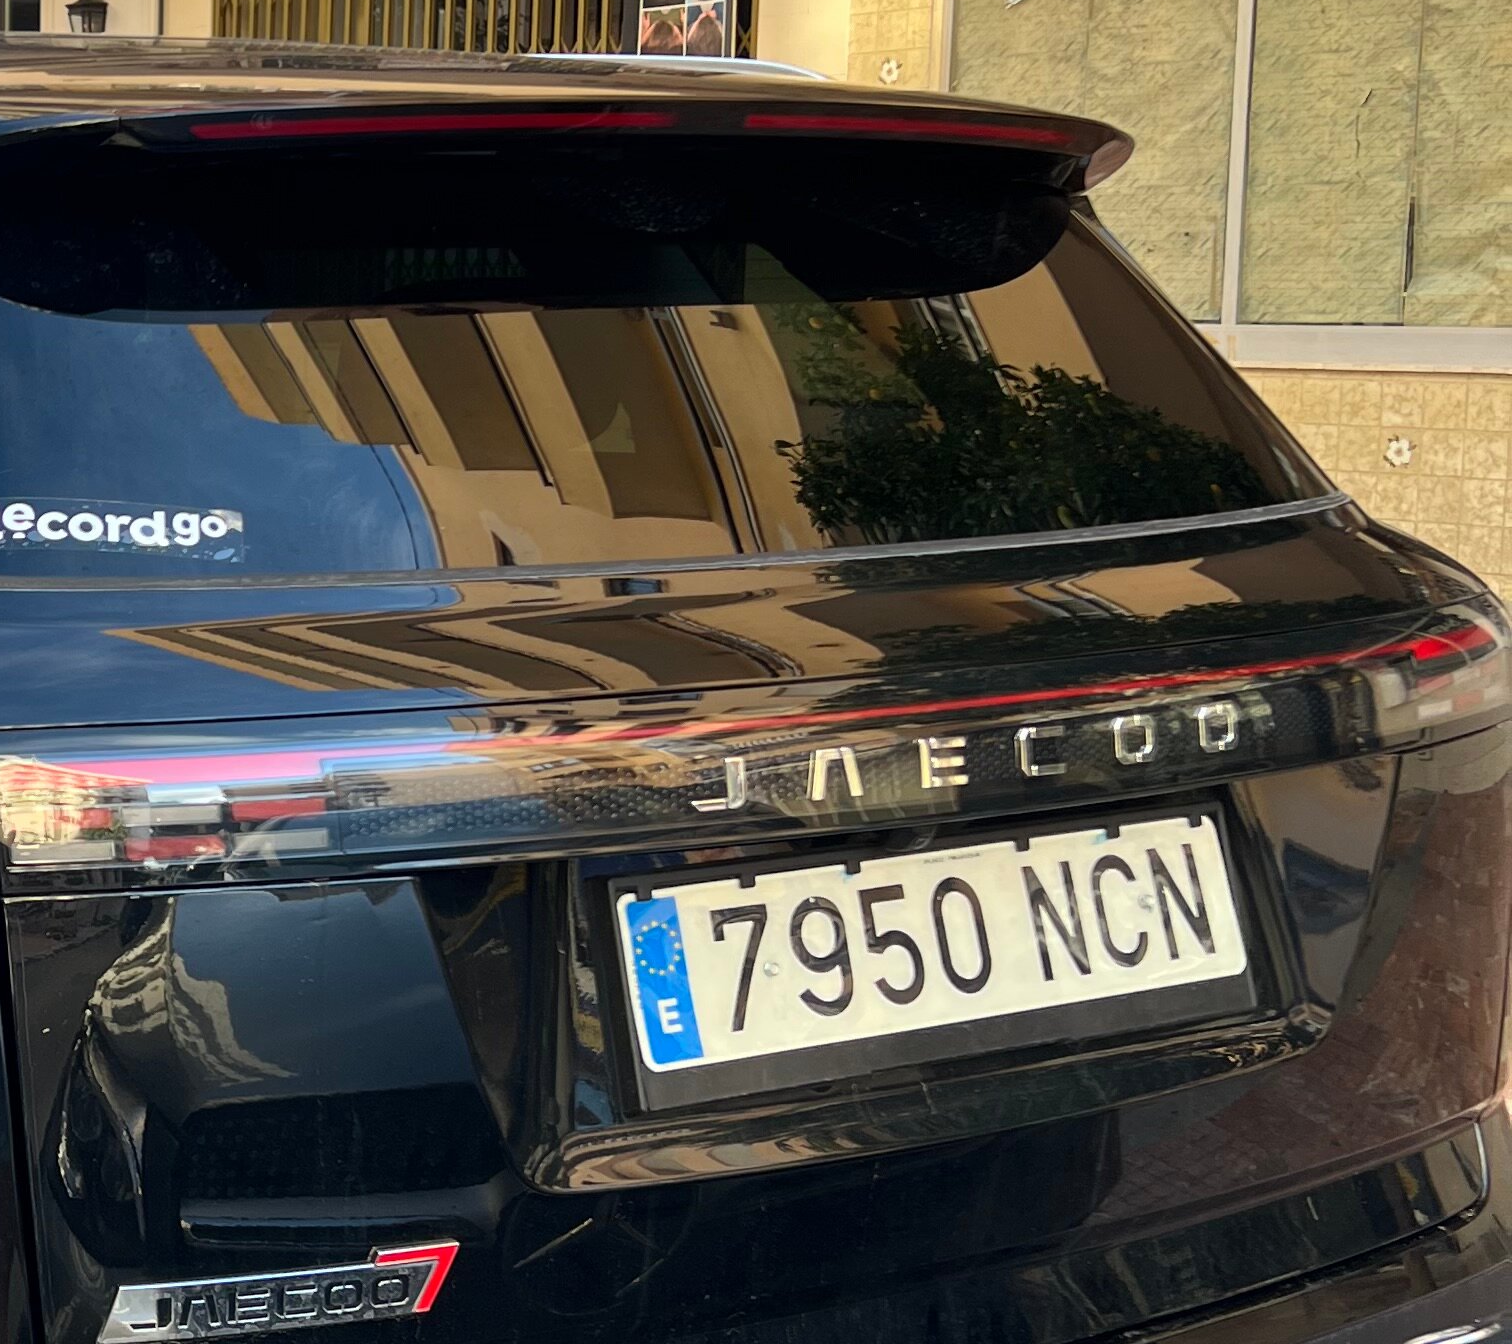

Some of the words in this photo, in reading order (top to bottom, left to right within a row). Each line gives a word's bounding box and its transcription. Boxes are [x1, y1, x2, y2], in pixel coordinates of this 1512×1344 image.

[691, 700, 1239, 813] JAECOO
[709, 876, 990, 1034] 7950
[1021, 842, 1217, 983] NCN
[657, 997, 684, 1035] E
[126, 1274, 410, 1333] JAECOO
